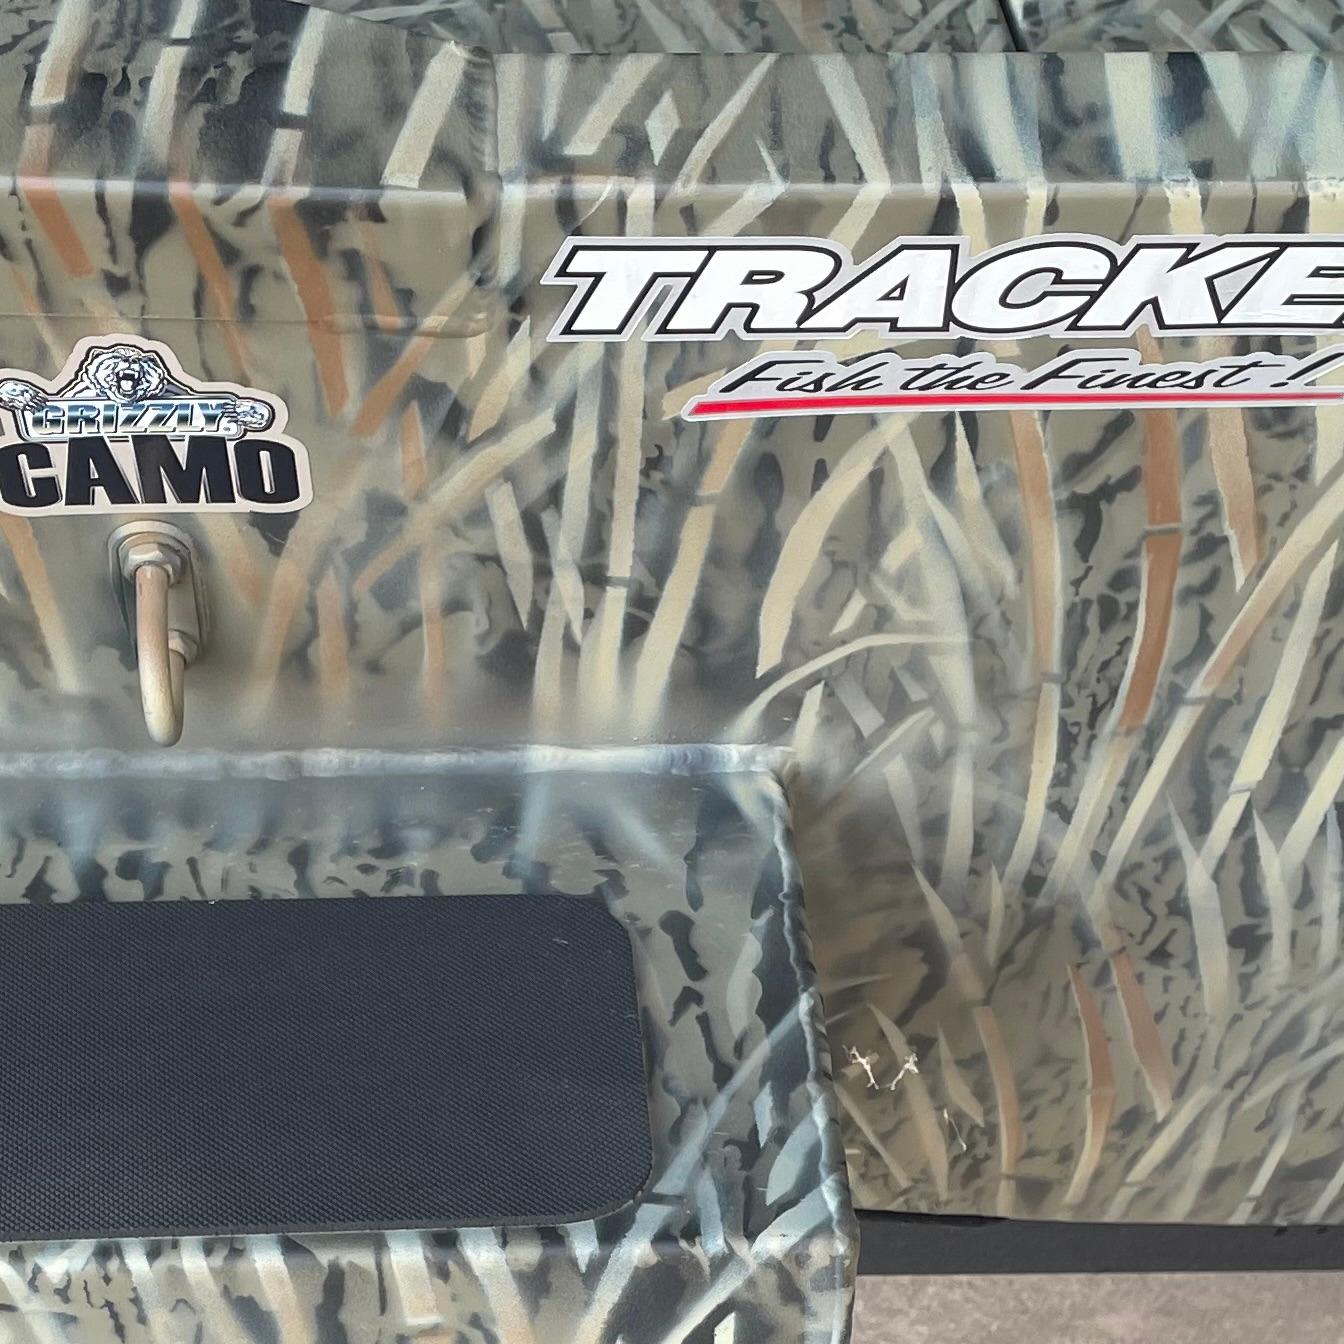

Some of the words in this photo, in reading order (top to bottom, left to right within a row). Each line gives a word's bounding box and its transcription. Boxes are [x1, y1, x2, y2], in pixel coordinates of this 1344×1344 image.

[719, 359, 884, 392] Fish
[899, 358, 1013, 391] the
[1020, 356, 1265, 391] Finest
[31, 402, 226, 434] GRIZZLY
